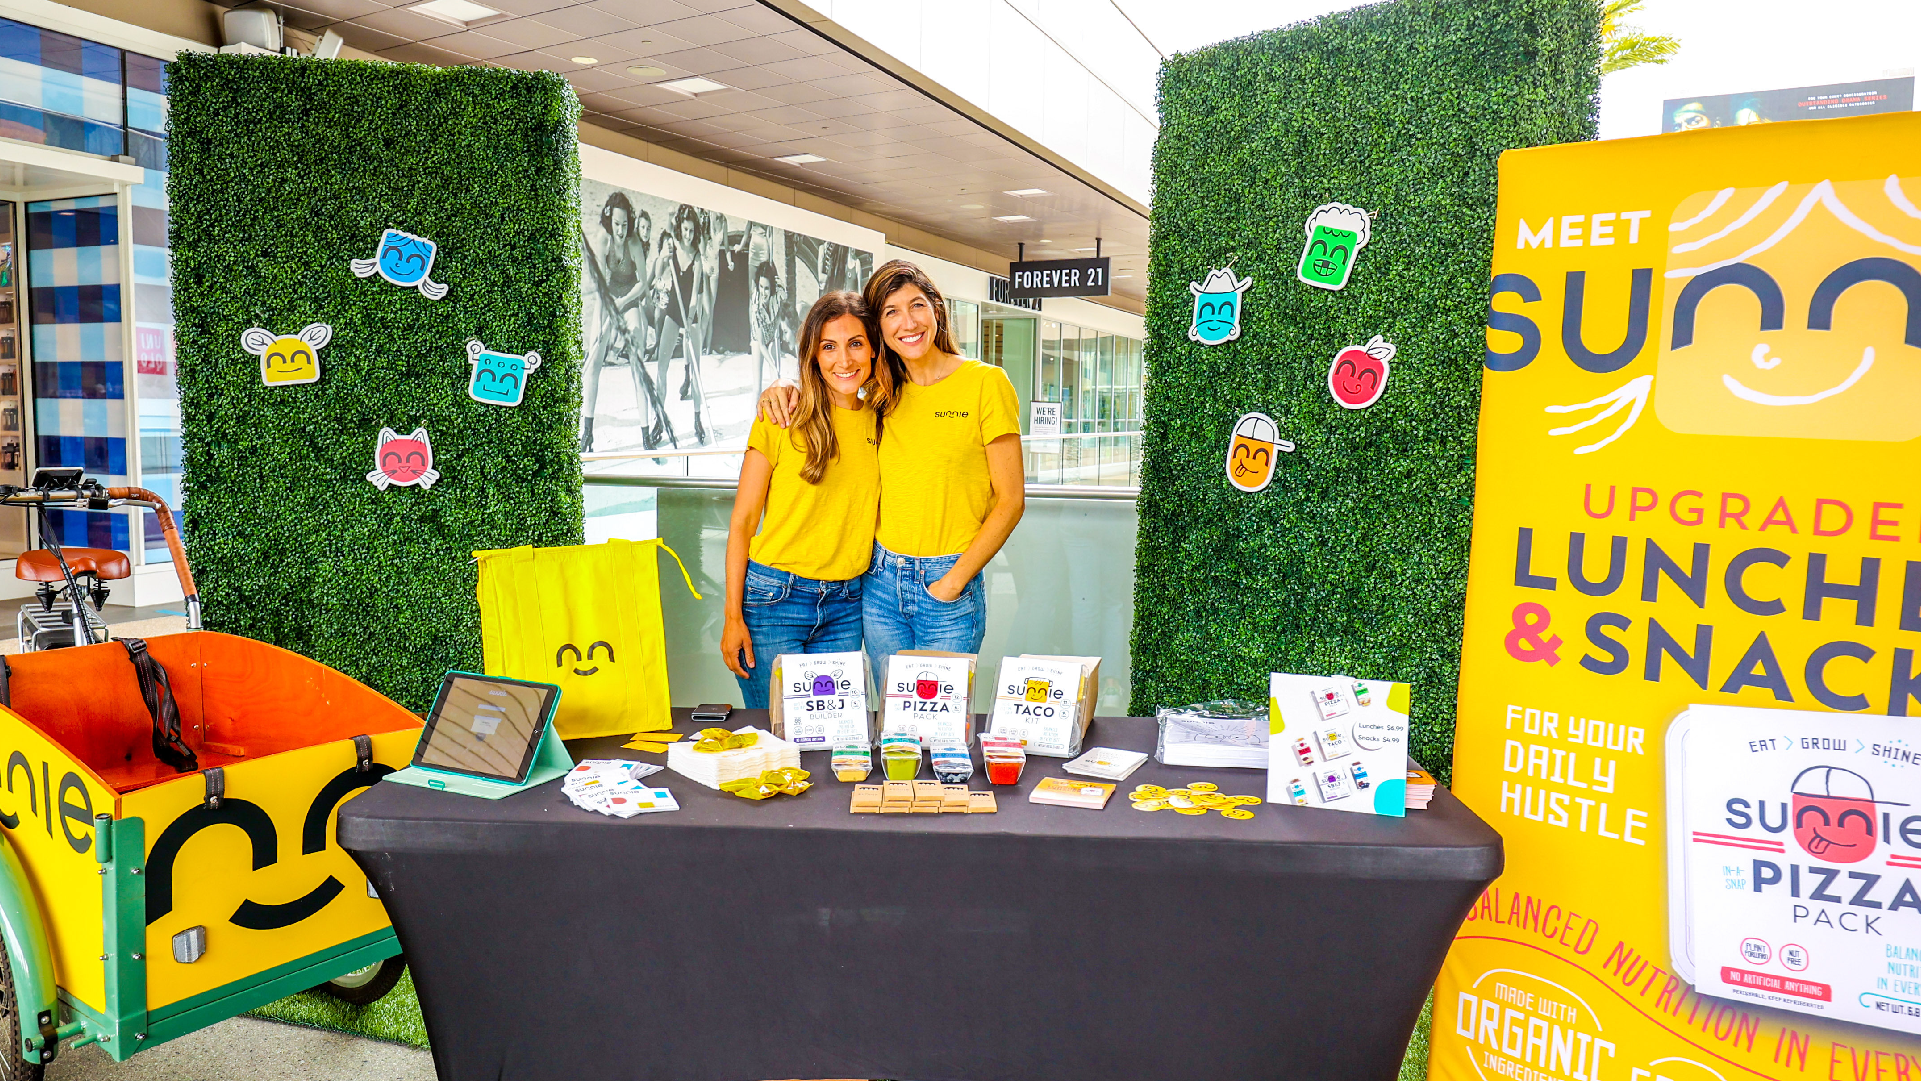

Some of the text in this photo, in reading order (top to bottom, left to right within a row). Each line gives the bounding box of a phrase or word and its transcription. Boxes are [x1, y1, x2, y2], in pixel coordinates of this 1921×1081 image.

[1516, 210, 1651, 249] MEET
[1014, 267, 1103, 289] FOREVER 21
[1036, 407, 1056, 416] WE'RE
[1034, 416, 1058, 426] HIRING!
[1584, 484, 1921, 543] UPGRADE
[1504, 602, 1563, 667] &
[806, 698, 844, 712] SB&J
[902, 700, 950, 712] PIZZA
[1014, 704, 1054, 718] TACO
[809, 712, 842, 720] BUILDER
[914, 712, 938, 720] PACK
[1386, 724, 1404, 732] $6.99
[1506, 704, 1645, 755] FOR YOUR
[1358, 734, 1380, 742] Snacks
[1749, 737, 1921, 766] EAT GROW SHINE
[1503, 739, 1616, 794] DAILY
[1500, 781, 1648, 846] HUSTLE
[1725, 878, 1746, 890] SNAP
[1753, 858, 1921, 915] PIZZA
[1793, 904, 1882, 936] PACK
[1746, 942, 1766, 953] PLANT
[1788, 950, 1800, 958] NUT
[1886, 944, 1921, 962] BALAN
[1786, 957, 1802, 966] FREE
[1888, 962, 1921, 978] NUTRI
[1730, 970, 1822, 996] NO ARTIFICIAL ANYTHING
[1877, 976, 1888, 990] IN
[1494, 982, 1577, 1024] MADE WITH
[1602, 940, 1761, 1053] NUTRITION
[1774, 1026, 1810, 1073] IN
[1828, 1041, 1921, 1081] EVER
[1876, 1000, 1890, 1012] NET
[1456, 990, 1616, 1081] ORGANIC
